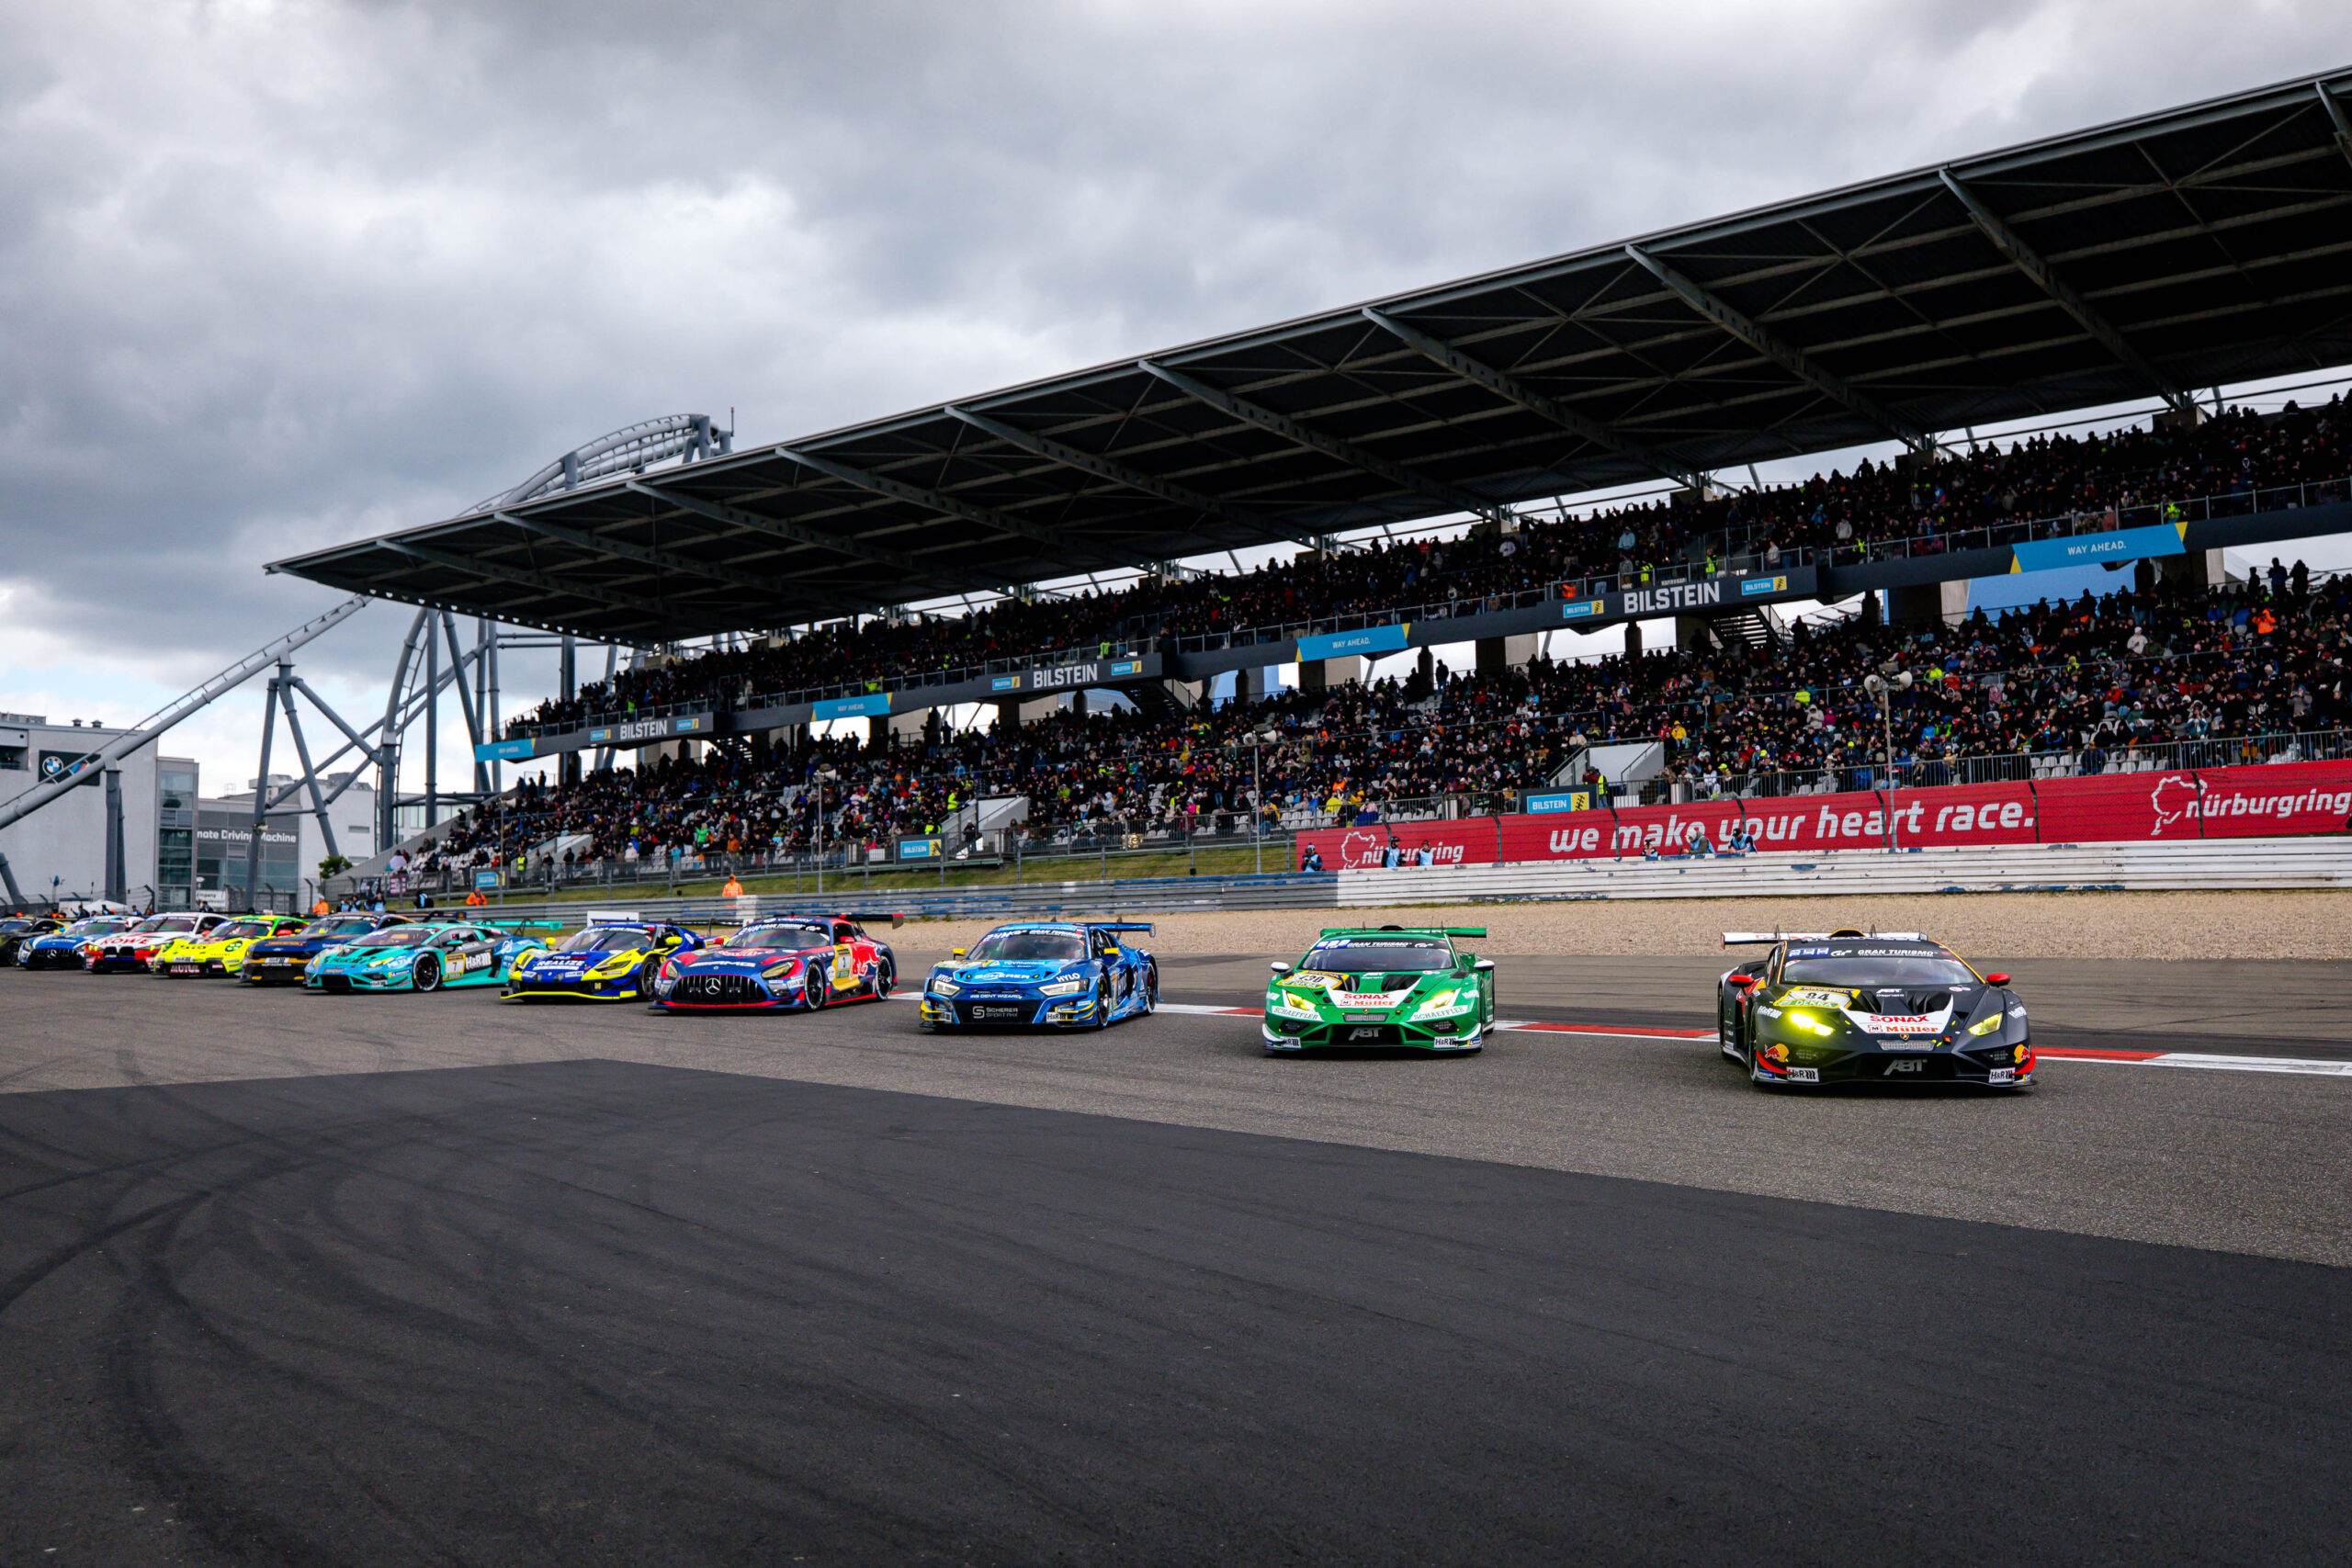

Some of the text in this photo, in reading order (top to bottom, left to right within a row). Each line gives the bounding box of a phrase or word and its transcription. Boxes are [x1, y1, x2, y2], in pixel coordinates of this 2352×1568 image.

[2067, 540, 2127, 556] WAY AHEAD.
[1746, 581, 1771, 592] BILSTEIN
[1623, 581, 1721, 615] BILSTEIN
[1566, 604, 1589, 615] BILSTEIN
[1332, 637, 1371, 649] WAY AHEAD.
[1033, 663, 1098, 689] BILSTEIN
[620, 719, 668, 740] BILSTEIN
[1532, 799, 1567, 810] BILSTEIN
[2185, 788, 2352, 818] nürburgring
[1549, 827, 1600, 853] we
[1716, 815, 1806, 852] your
[1815, 801, 1925, 839] heart
[1935, 802, 2034, 832] race.
[903, 844, 928, 854] BILSTEIN
[170, 964, 200, 973] MOTUL
[452, 962, 458, 971] 7
[1056, 973, 1080, 983] HYLO
[1273, 1007, 1318, 1020] SCHAEFFLER
[1413, 1006, 1465, 1020] SCHAEFFLER
[1870, 1015, 1929, 1023] SONAX
[1348, 1027, 1383, 1041] ABT
[1883, 1059, 1928, 1076] ABT
